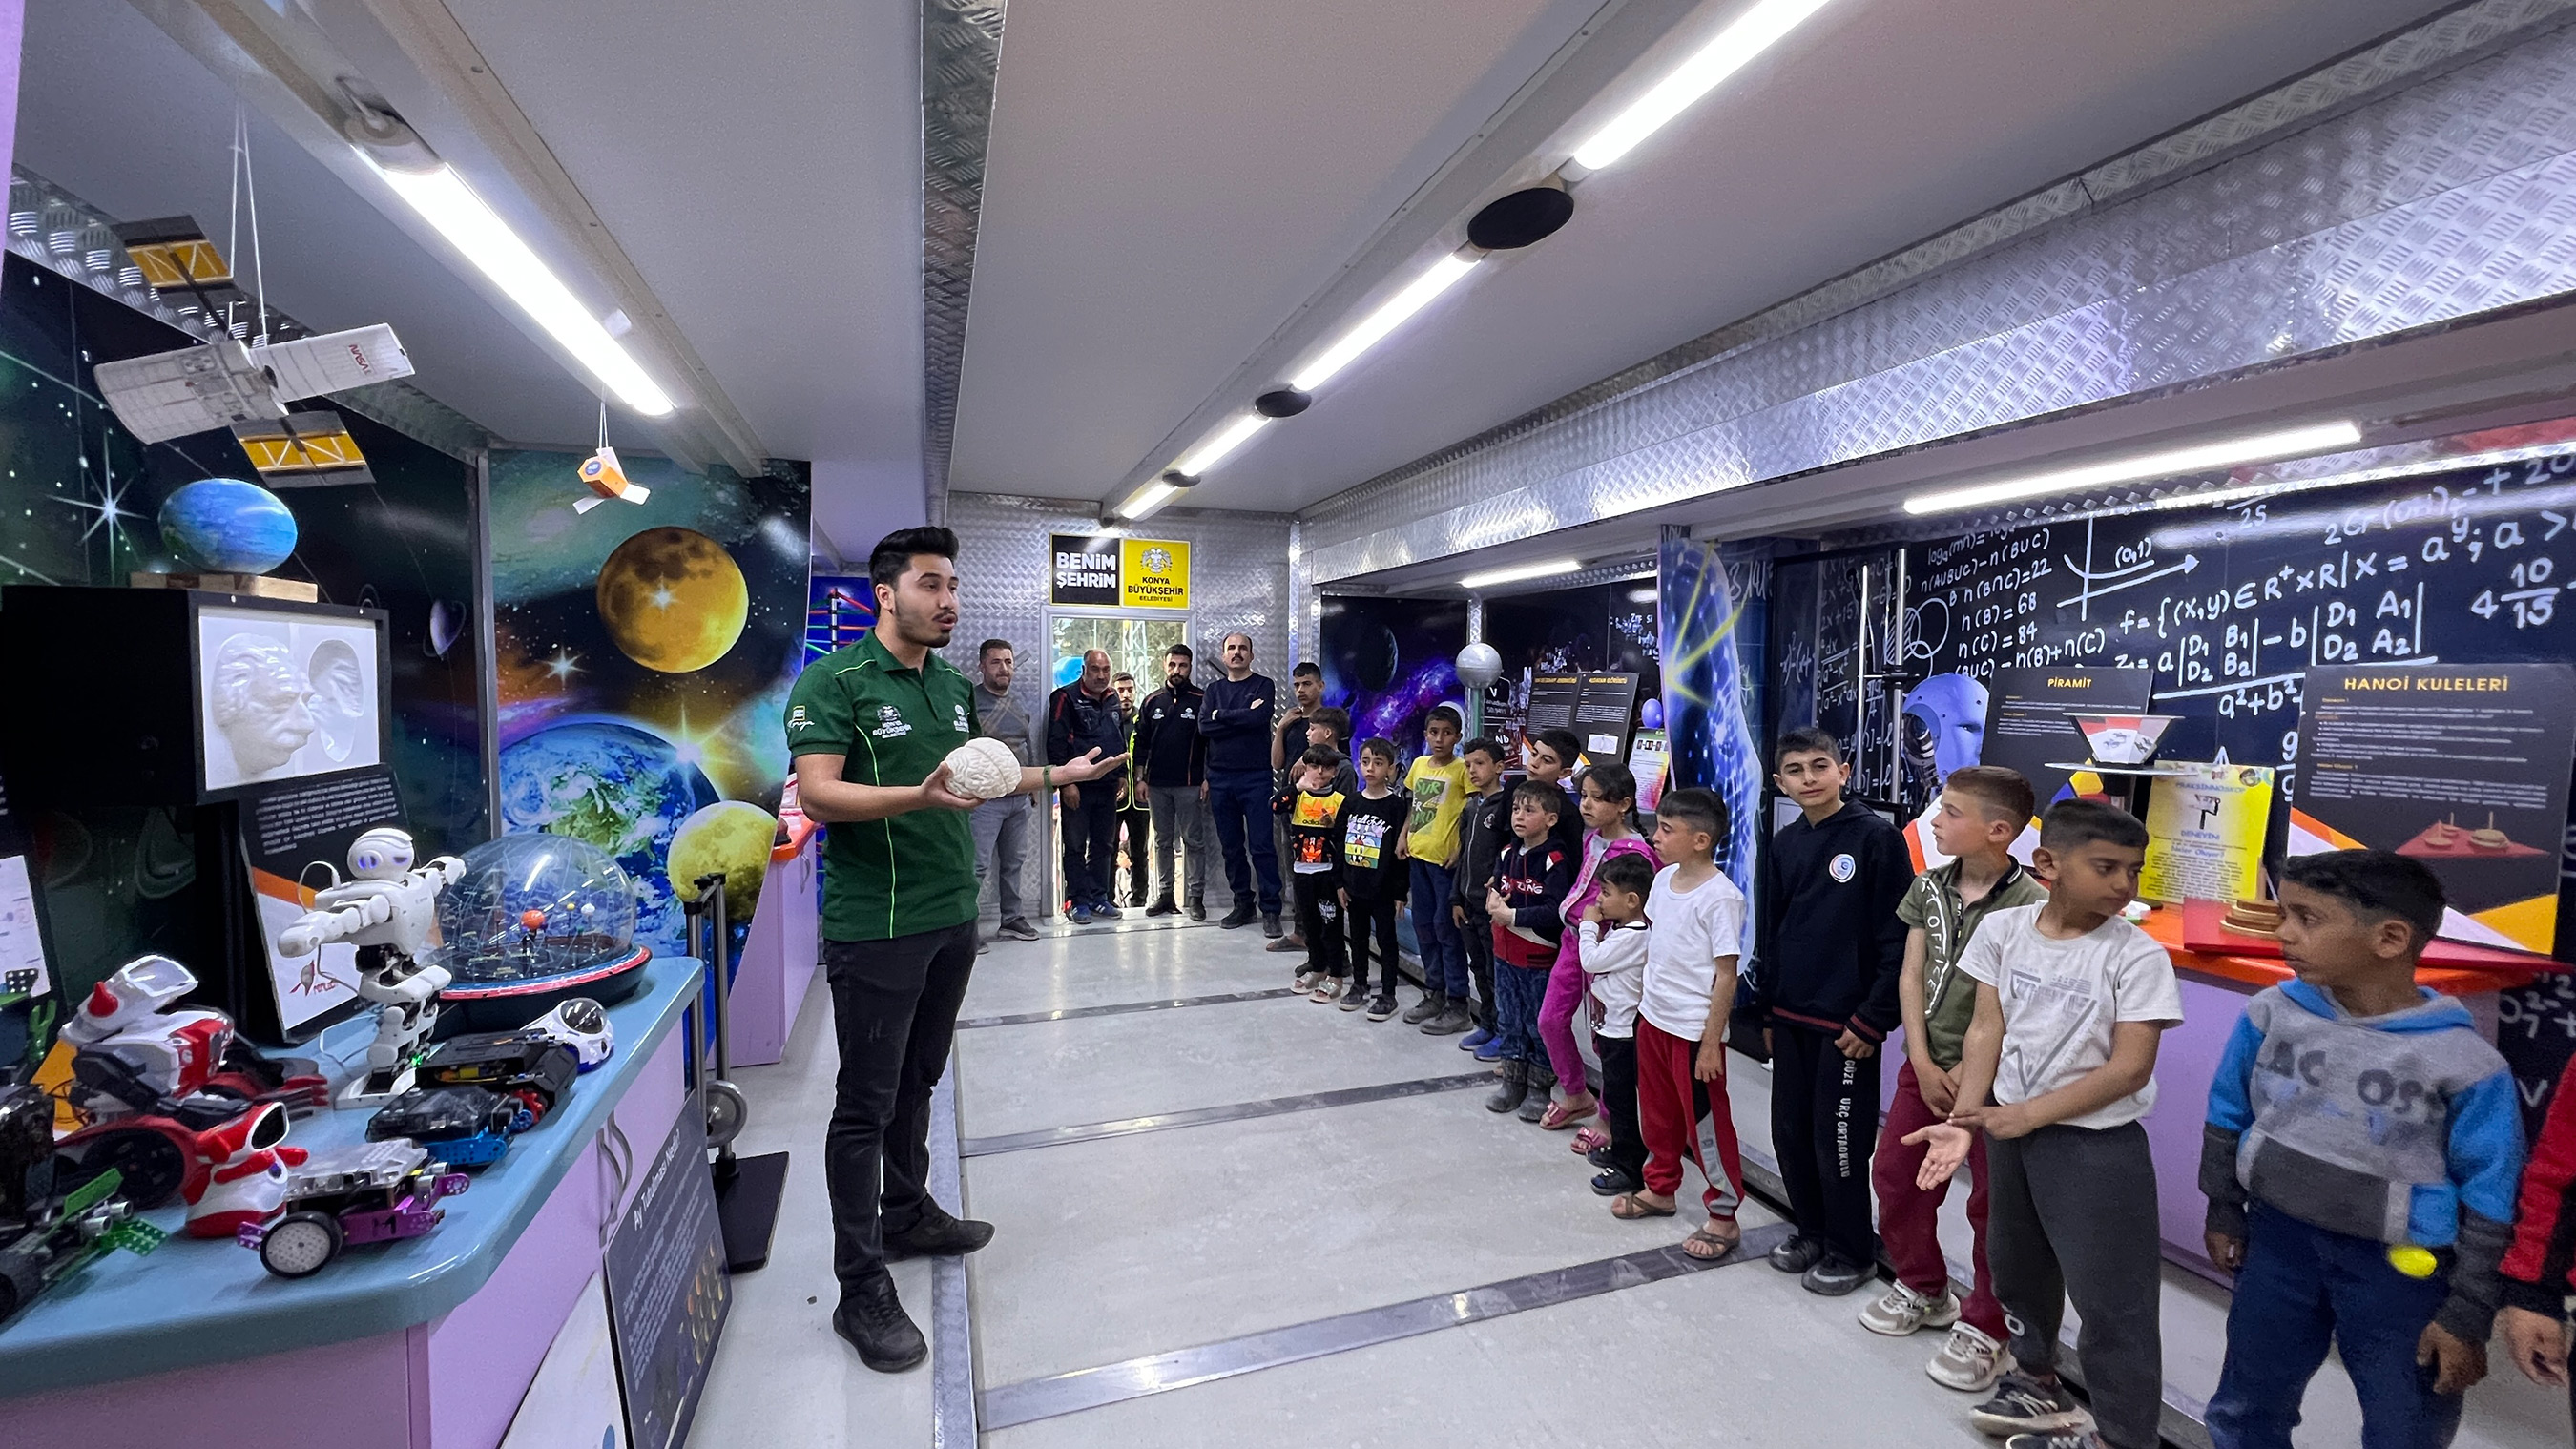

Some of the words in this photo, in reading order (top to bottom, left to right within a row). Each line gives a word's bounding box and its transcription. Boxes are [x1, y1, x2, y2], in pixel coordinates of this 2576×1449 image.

[1142, 576, 1171, 585] KONYA
[1127, 585, 1184, 596] BÜYÜKŞEHİR
[2046, 676, 2092, 689] PİRAMİT
[2344, 674, 2410, 692] HANOİ
[2416, 674, 2509, 692] KULELERİ
